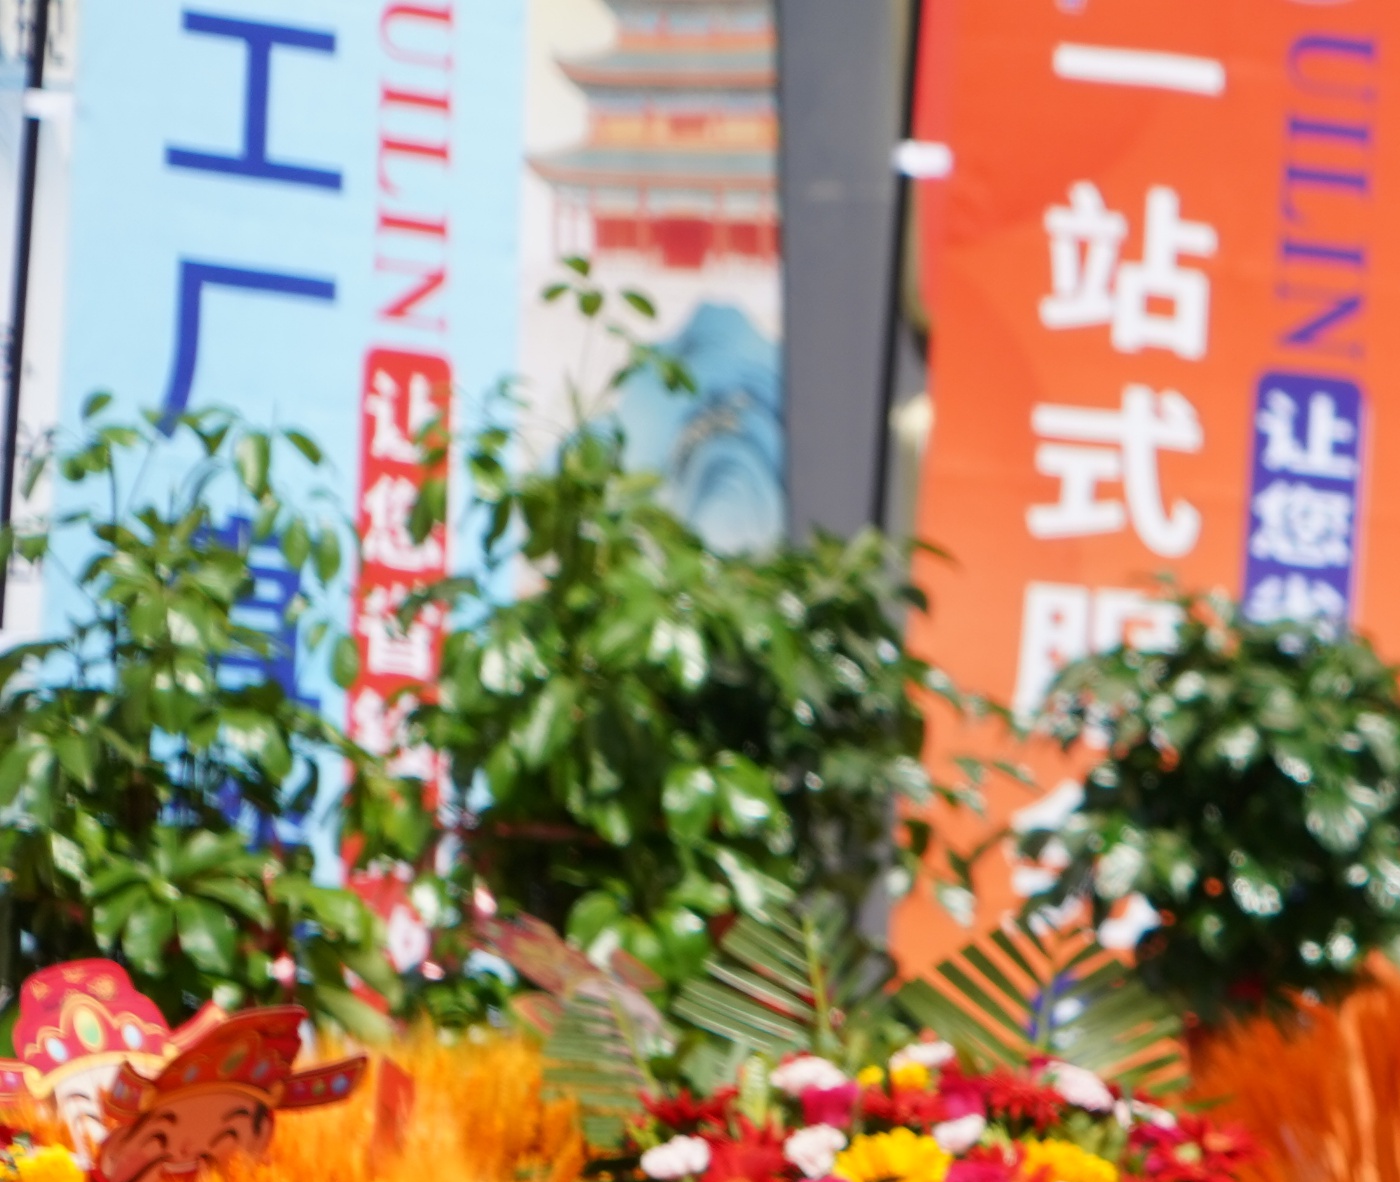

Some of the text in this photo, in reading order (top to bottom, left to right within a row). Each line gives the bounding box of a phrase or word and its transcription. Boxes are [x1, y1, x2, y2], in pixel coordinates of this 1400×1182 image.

[163, 10, 345, 855] 工厂直
[1012, 42, 1226, 952] 一站式服
[1273, 32, 1377, 363] UILIN
